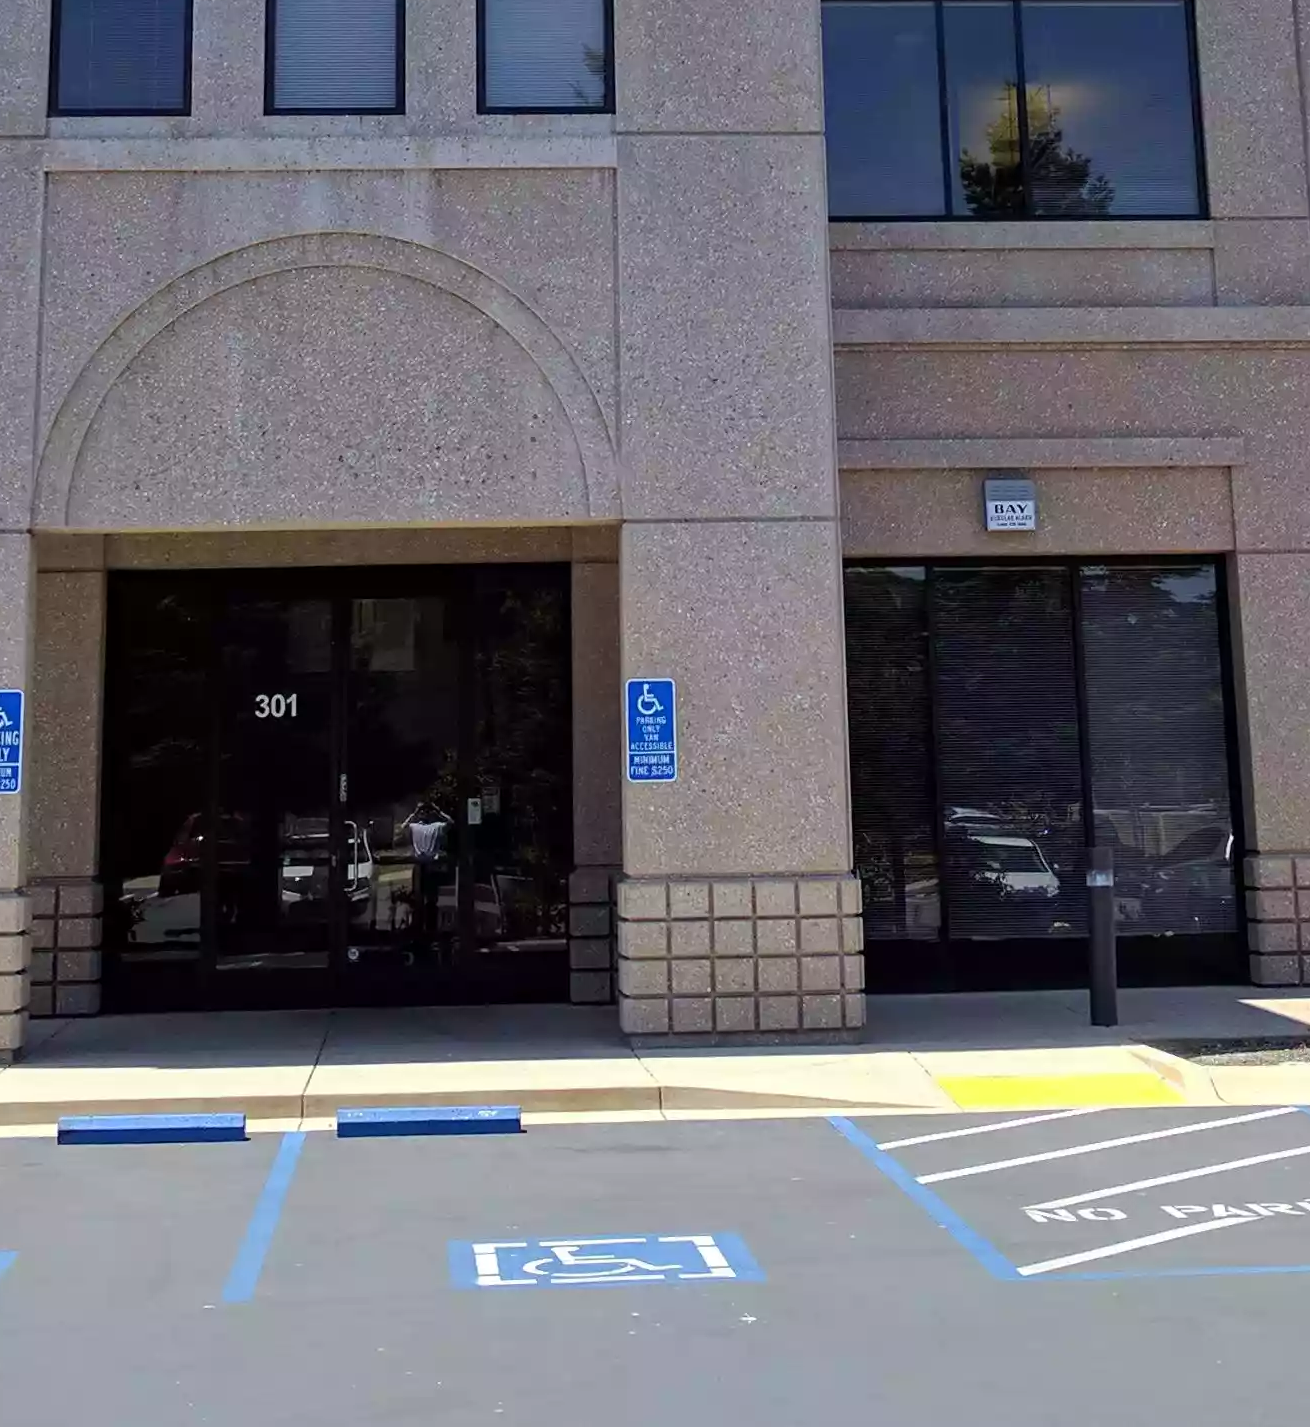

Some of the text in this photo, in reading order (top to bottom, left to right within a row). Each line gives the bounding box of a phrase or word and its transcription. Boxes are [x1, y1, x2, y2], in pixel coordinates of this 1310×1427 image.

[994, 504, 1027, 514] BAY
[254, 693, 297, 718] 301
[636, 716, 667, 725] PARKING
[642, 725, 661, 733] ONLY
[631, 741, 673, 750] ACCESSIBLE
[634, 756, 670, 765] MINIMUM
[631, 765, 673, 775] FINE $250
[1024, 1206, 1128, 1224] NO
